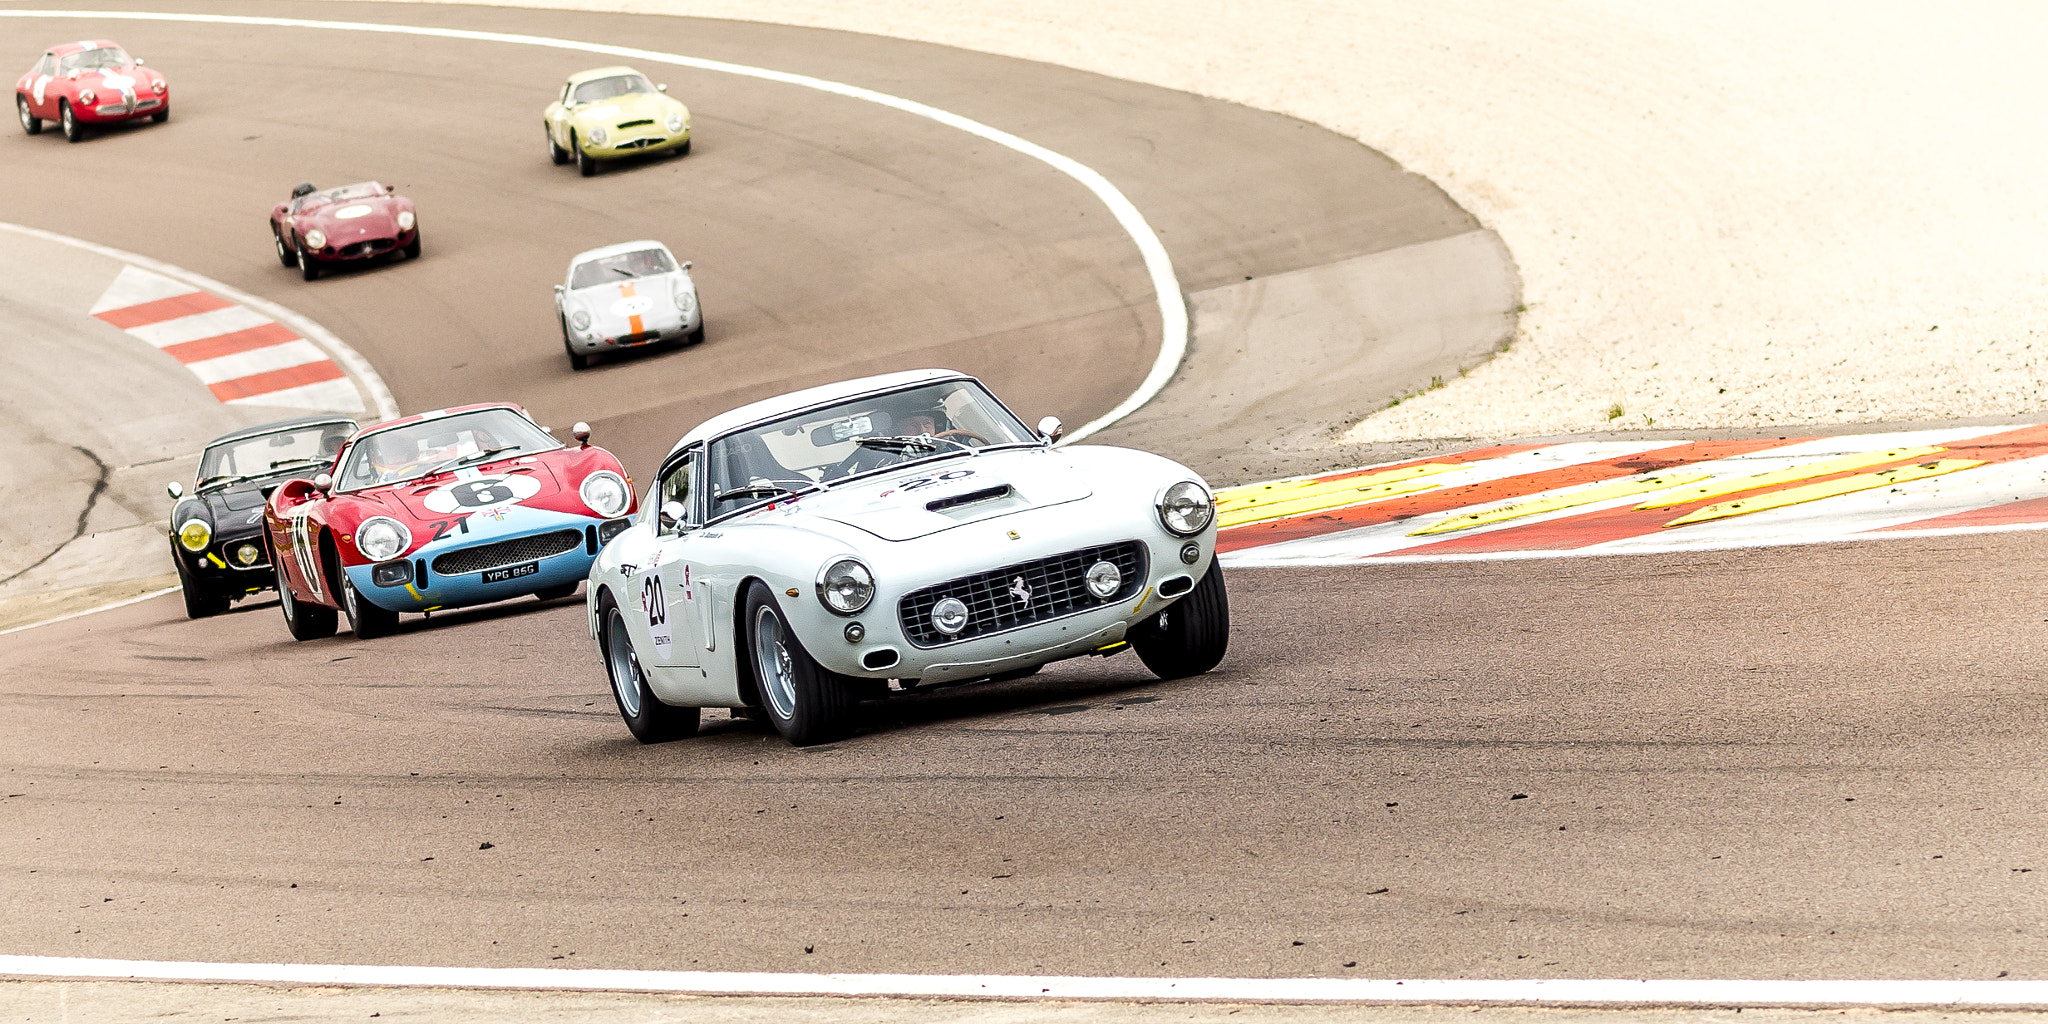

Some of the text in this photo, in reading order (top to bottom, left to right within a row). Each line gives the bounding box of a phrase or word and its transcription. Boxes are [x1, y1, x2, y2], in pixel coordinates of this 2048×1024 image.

[451, 478, 514, 507] 6
[898, 470, 976, 492] 20
[430, 516, 470, 542] 21
[487, 570, 510, 582] YPG
[644, 574, 666, 627] 20
[654, 635, 672, 646] ZENITH
